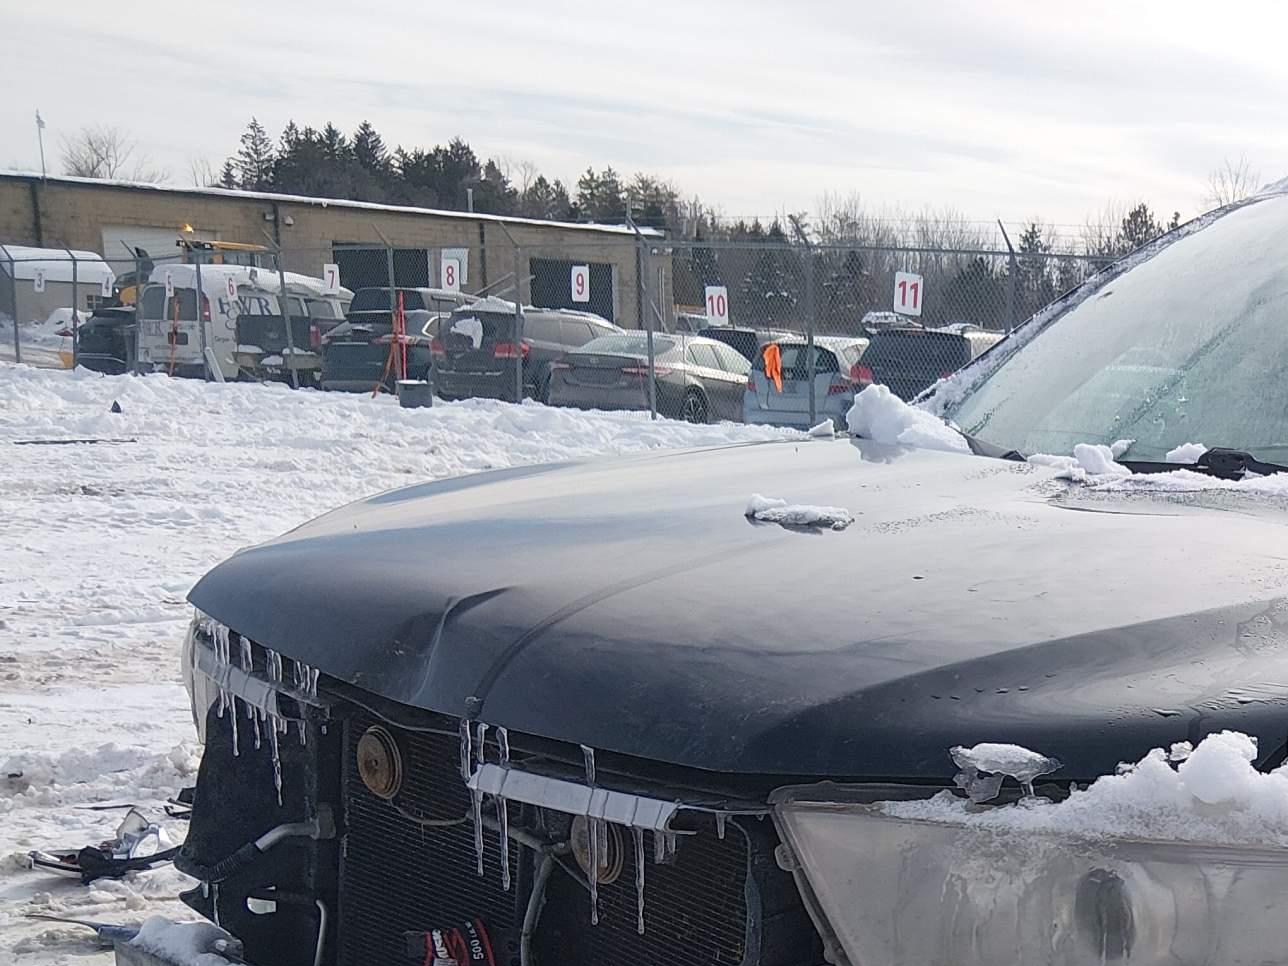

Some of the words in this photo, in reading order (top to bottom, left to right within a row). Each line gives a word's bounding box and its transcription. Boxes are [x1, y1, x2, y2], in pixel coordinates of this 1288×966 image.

[228, 278, 235, 296] 6
[327, 270, 335, 289] 7
[446, 265, 455, 287] 8
[574, 271, 586, 295] 9
[898, 280, 919, 309] 11
[707, 295, 726, 317] 10
